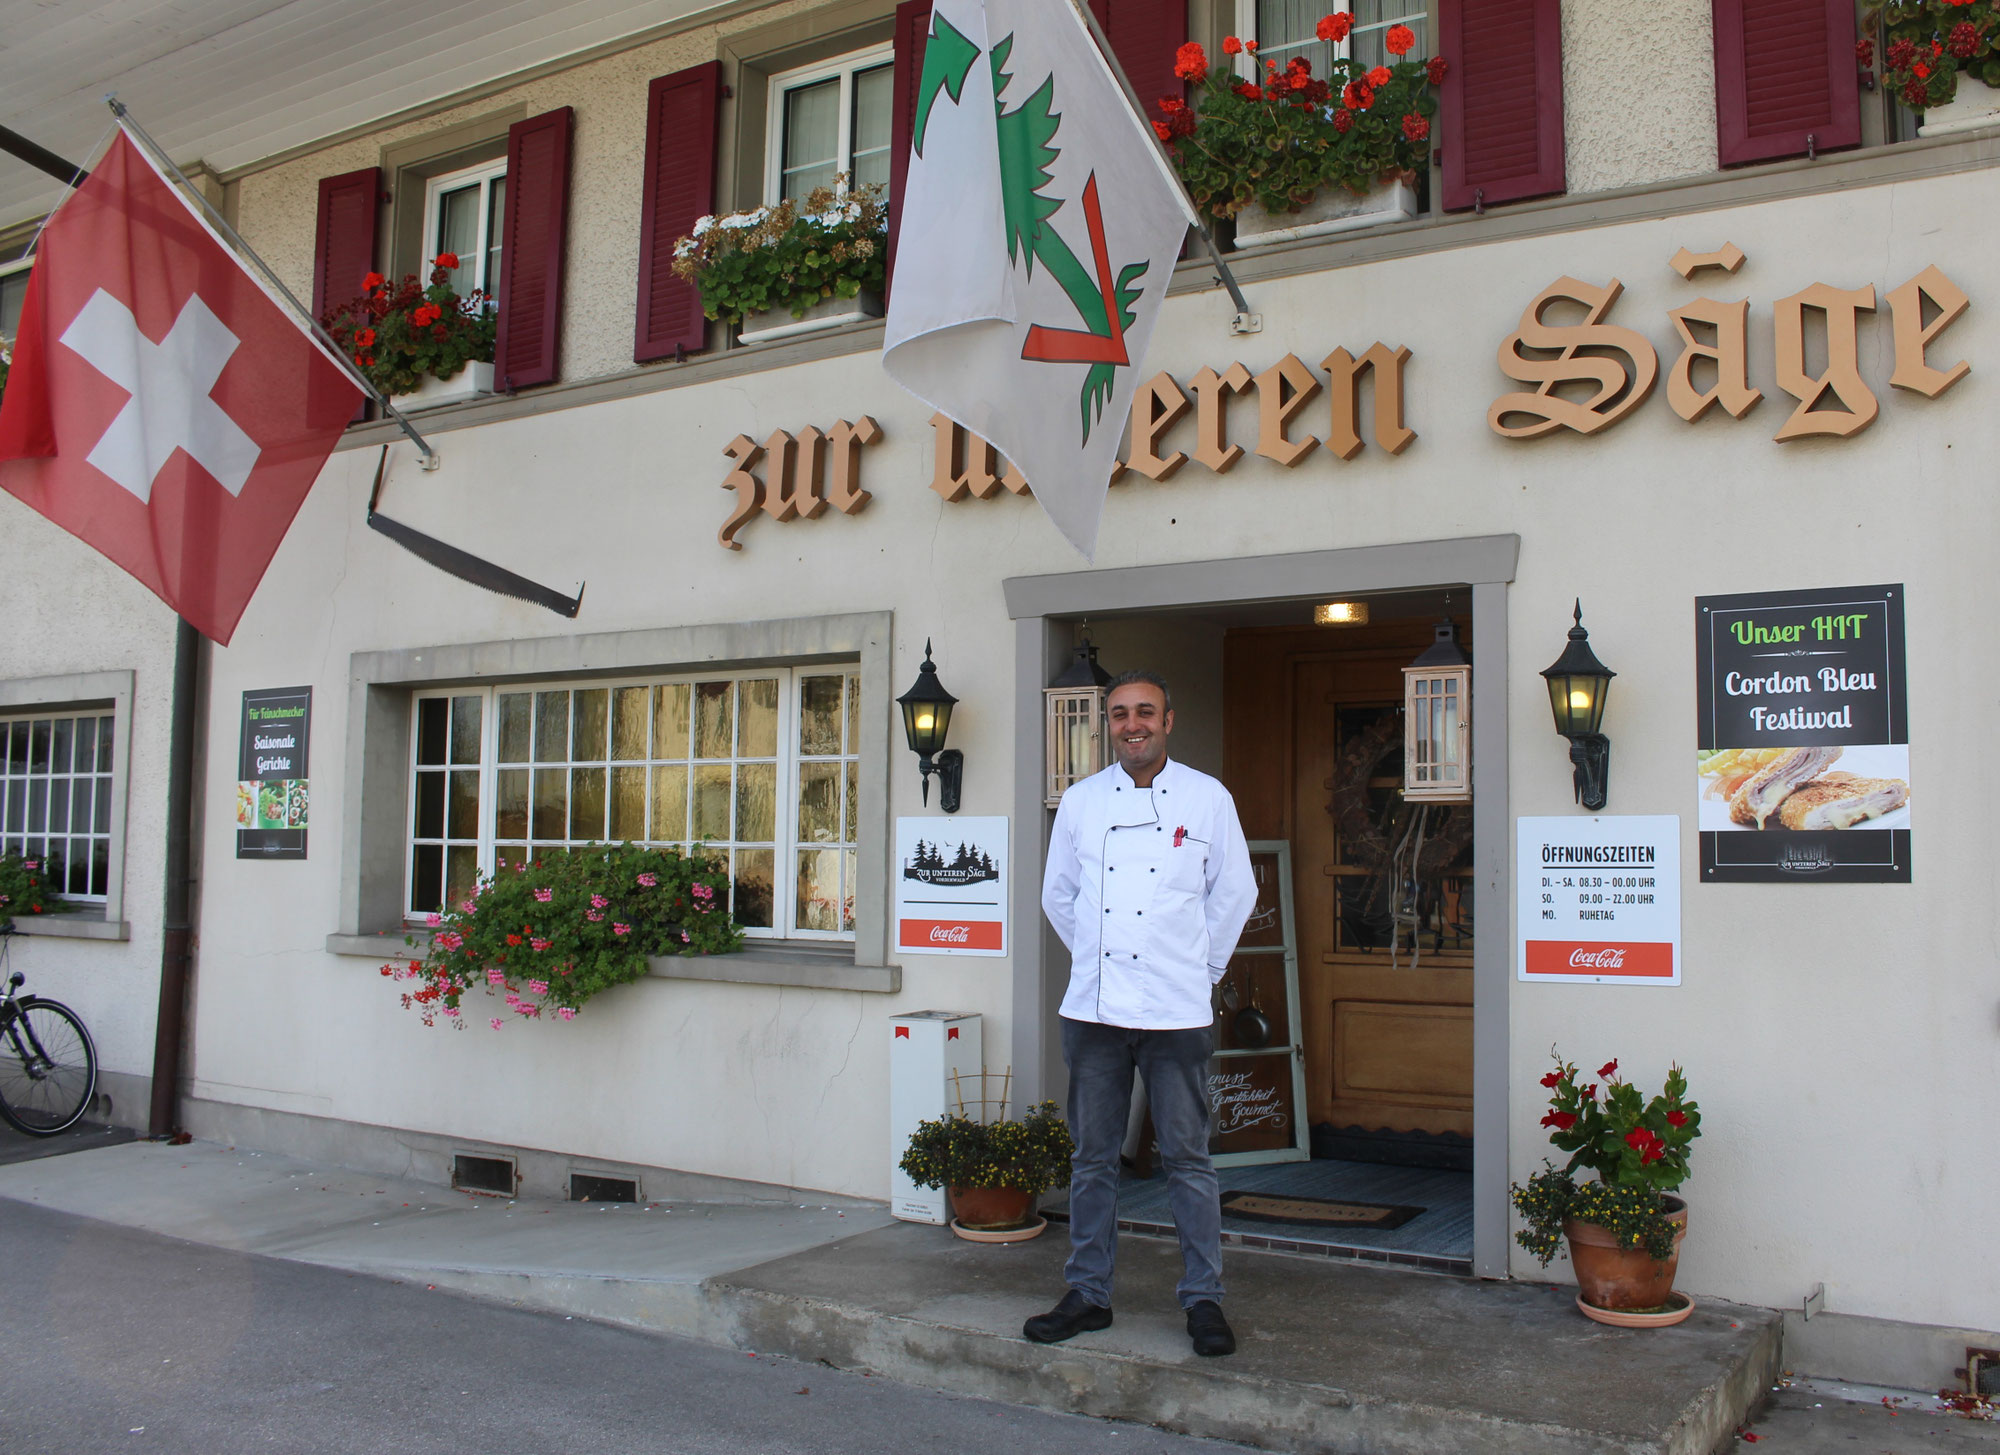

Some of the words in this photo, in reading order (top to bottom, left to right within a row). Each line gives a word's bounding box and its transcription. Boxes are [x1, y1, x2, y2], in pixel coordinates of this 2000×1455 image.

[718, 414, 883, 551] zur
[1487, 240, 1972, 444] Säge
[1730, 620, 1806, 645] Unser
[1811, 614, 1869, 641] HIT
[1725, 671, 1812, 696] Cordon
[1817, 666, 1877, 692] Bleu
[254, 734, 296, 750] Saisonale
[256, 756, 291, 775] Gerichte
[1542, 843, 1655, 863] ÖFFNUNGSZEITEN
[1542, 877, 1553, 888] DI.
[1562, 877, 1576, 888] SA.
[1579, 877, 1602, 888] 08.30
[1612, 878, 1637, 888] 00.00
[1638, 878, 1655, 888] UHR
[1542, 894, 1555, 904] SO.
[1579, 894, 1603, 904] 09.00
[1612, 894, 1636, 905] 22.00
[1637, 894, 1655, 905] UHR
[1542, 910, 1557, 920] MO.
[1579, 910, 1615, 921] RUHETAG
[1569, 947, 1627, 969] Coca-Cola
